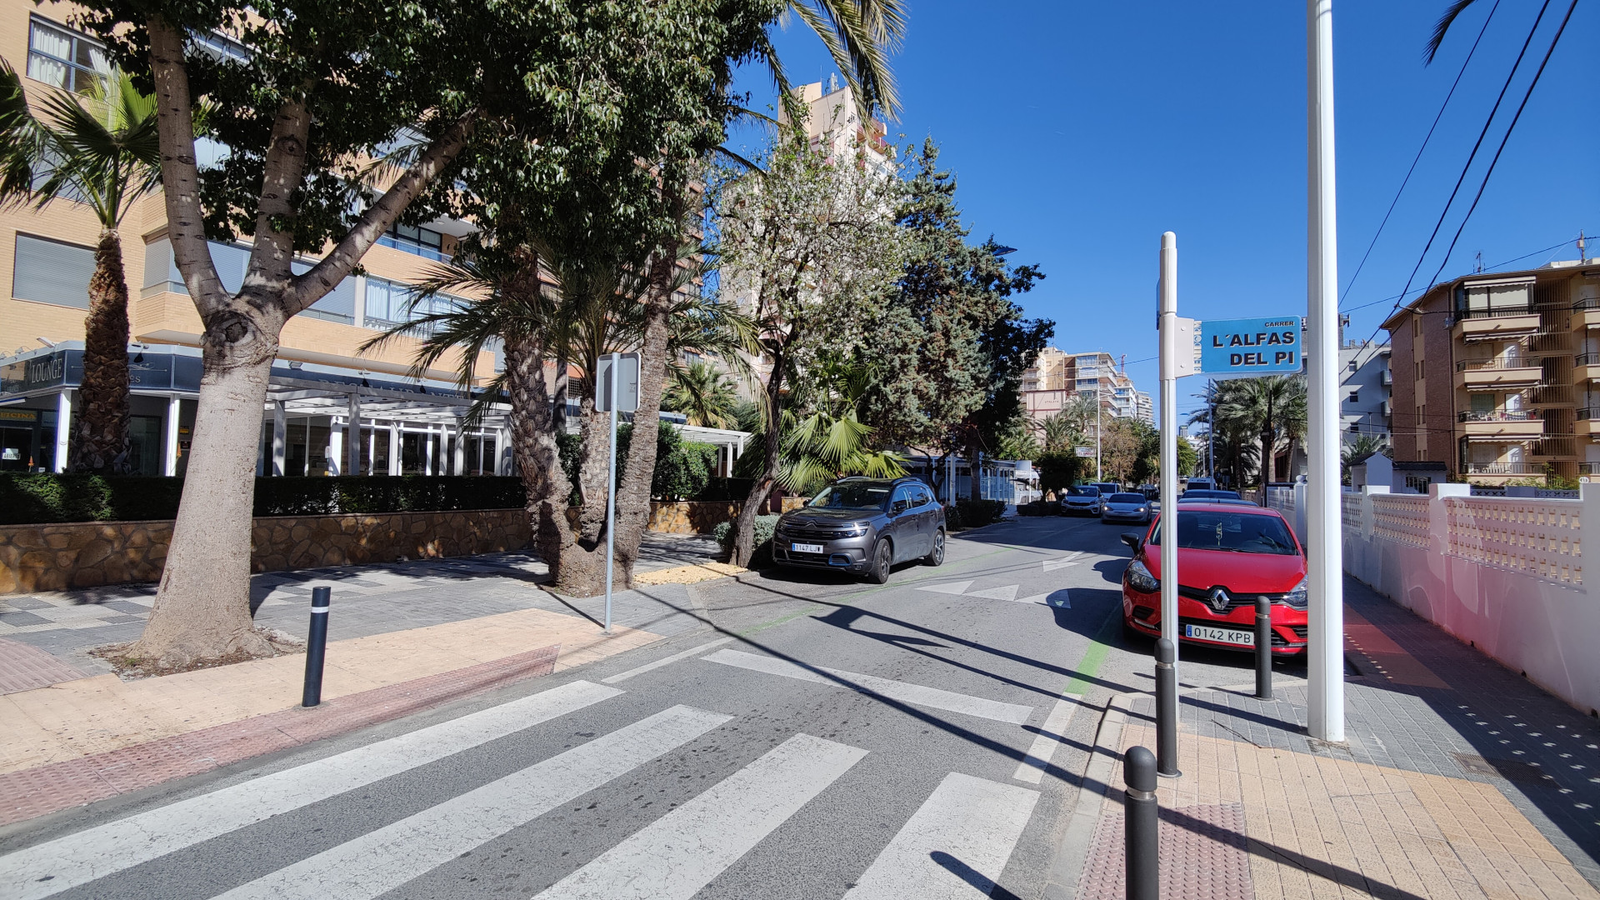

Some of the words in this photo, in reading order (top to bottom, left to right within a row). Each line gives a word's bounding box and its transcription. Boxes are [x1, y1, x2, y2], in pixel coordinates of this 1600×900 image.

[1264, 320, 1295, 328] CARRER
[1230, 352, 1268, 366] DEL
[1275, 351, 1295, 365] PI
[31, 358, 63, 384] LOUNGE
[1194, 627, 1224, 640] 0142
[1227, 631, 1251, 644] KPB
